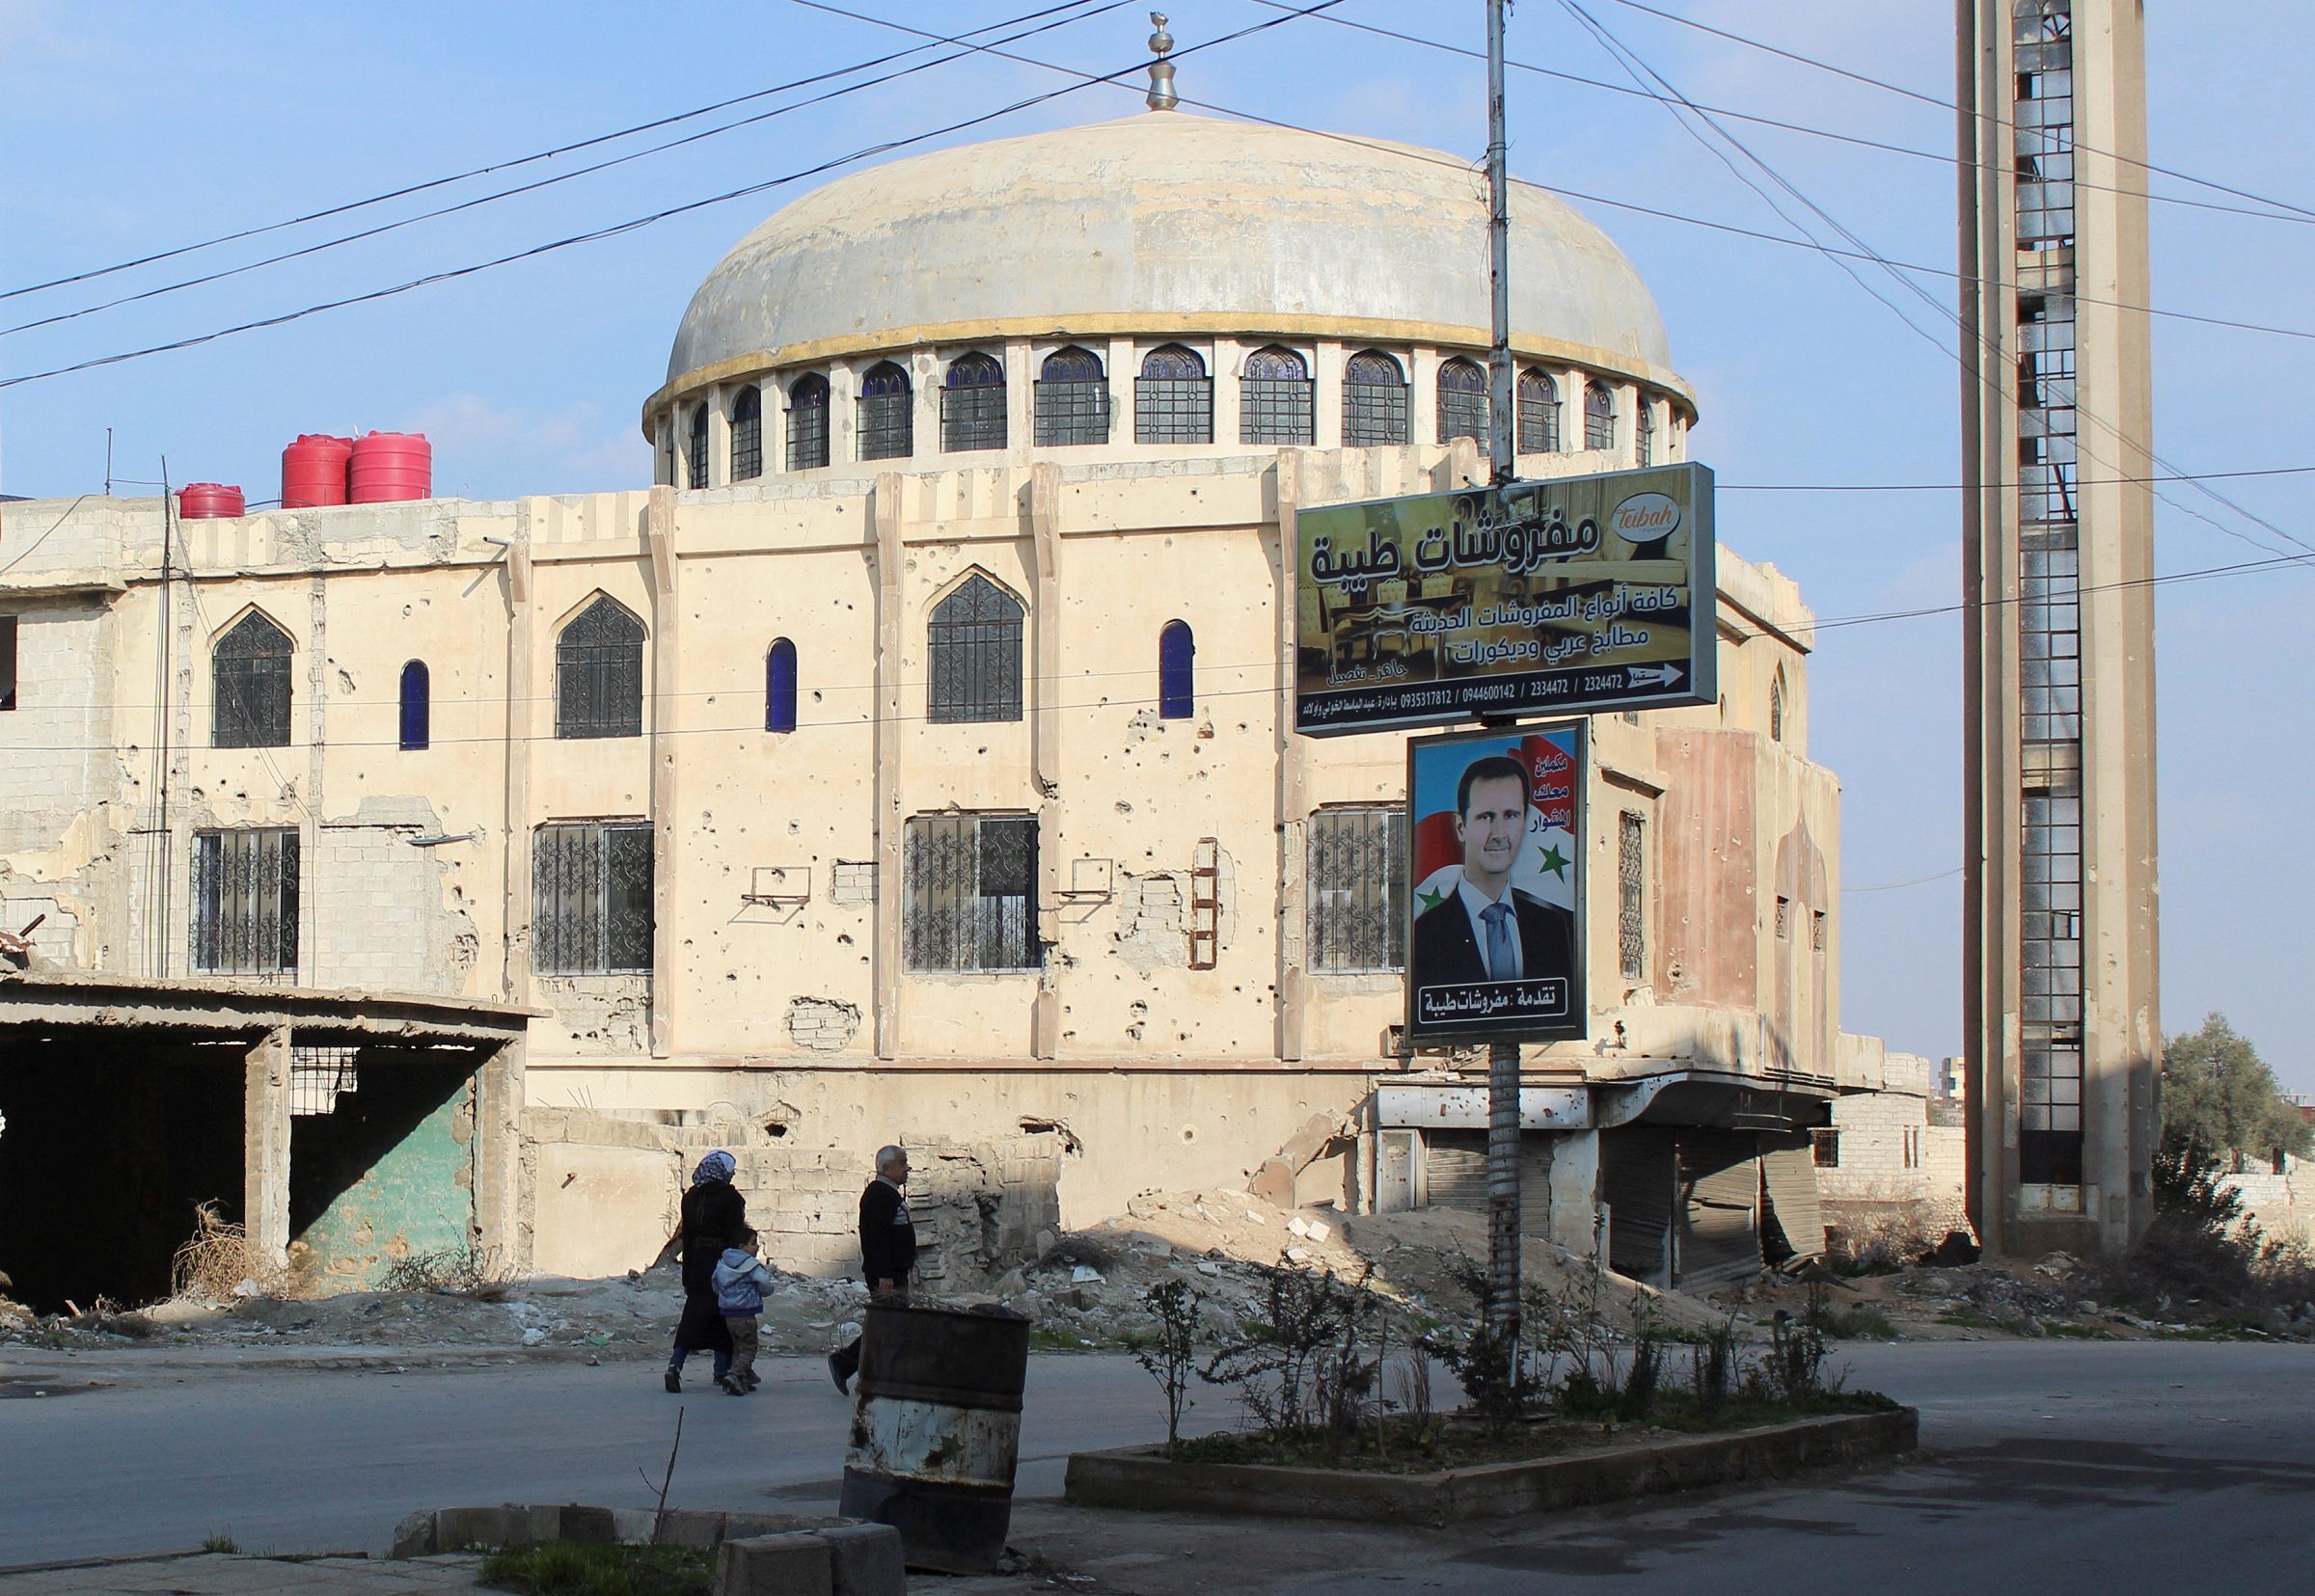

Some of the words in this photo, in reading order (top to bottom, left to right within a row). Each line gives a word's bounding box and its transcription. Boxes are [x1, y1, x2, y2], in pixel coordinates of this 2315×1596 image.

[1616, 503, 1672, 528] Teibah
[1415, 508, 1599, 574] مفروشات
[1310, 529, 1401, 593] طيبة
[1478, 595, 1578, 628] المفروشات
[1584, 582, 1627, 622] أنواع
[1633, 586, 1677, 611] كافة
[1410, 607, 1472, 636] الحديثة
[1454, 637, 1539, 663] وديكورات
[1544, 635, 1586, 663] عربي
[1592, 626, 1648, 655] مطابخ
[1326, 664, 1367, 687] تفصيل
[1401, 690, 1452, 709] 0935317812
[1462, 684, 1514, 702] 0944600142
[1531, 678, 1568, 696] 2334472
[1584, 674, 1622, 691] 2324472
[1535, 752, 1568, 777] مكملين
[1534, 783, 1569, 801] معك
[1530, 808, 1570, 833] المشوار
[1425, 991, 1457, 1016] طيبة
[1457, 988, 1509, 1014] مفروشات
